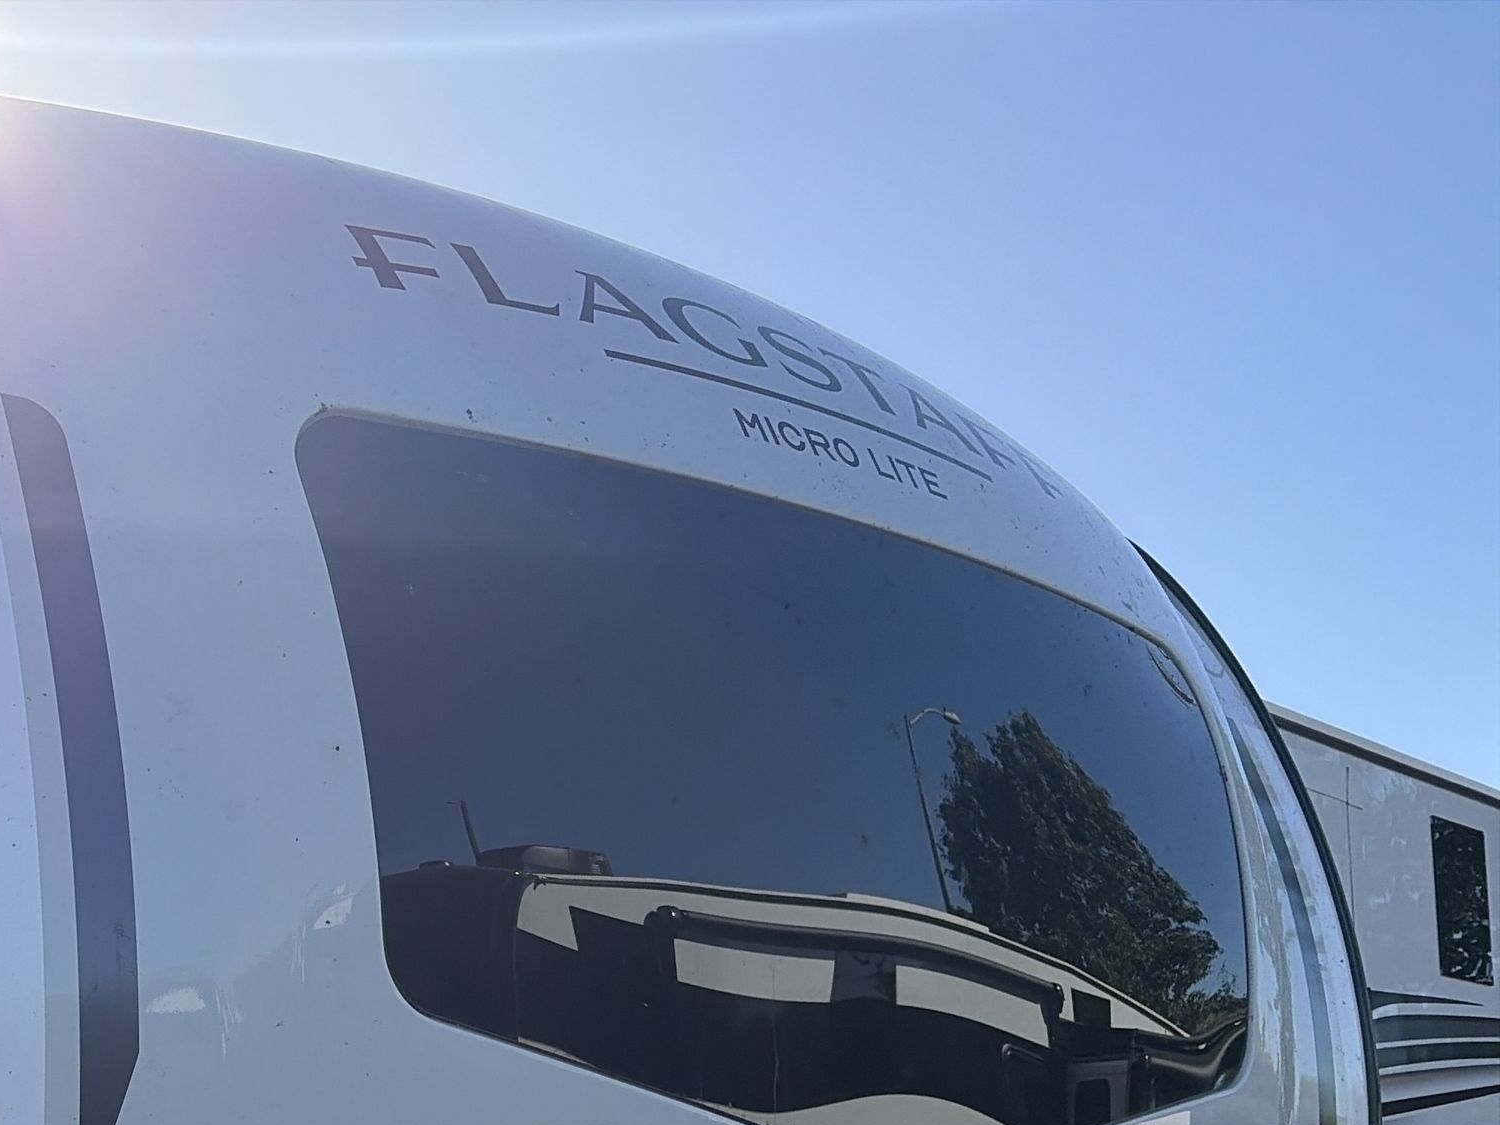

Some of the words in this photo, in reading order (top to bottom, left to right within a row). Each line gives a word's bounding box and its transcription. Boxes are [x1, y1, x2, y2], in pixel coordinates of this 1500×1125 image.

[344, 224, 1064, 500] FLAGSTAFF
[733, 408, 861, 468] MICRO
[871, 447, 948, 500] LITE
